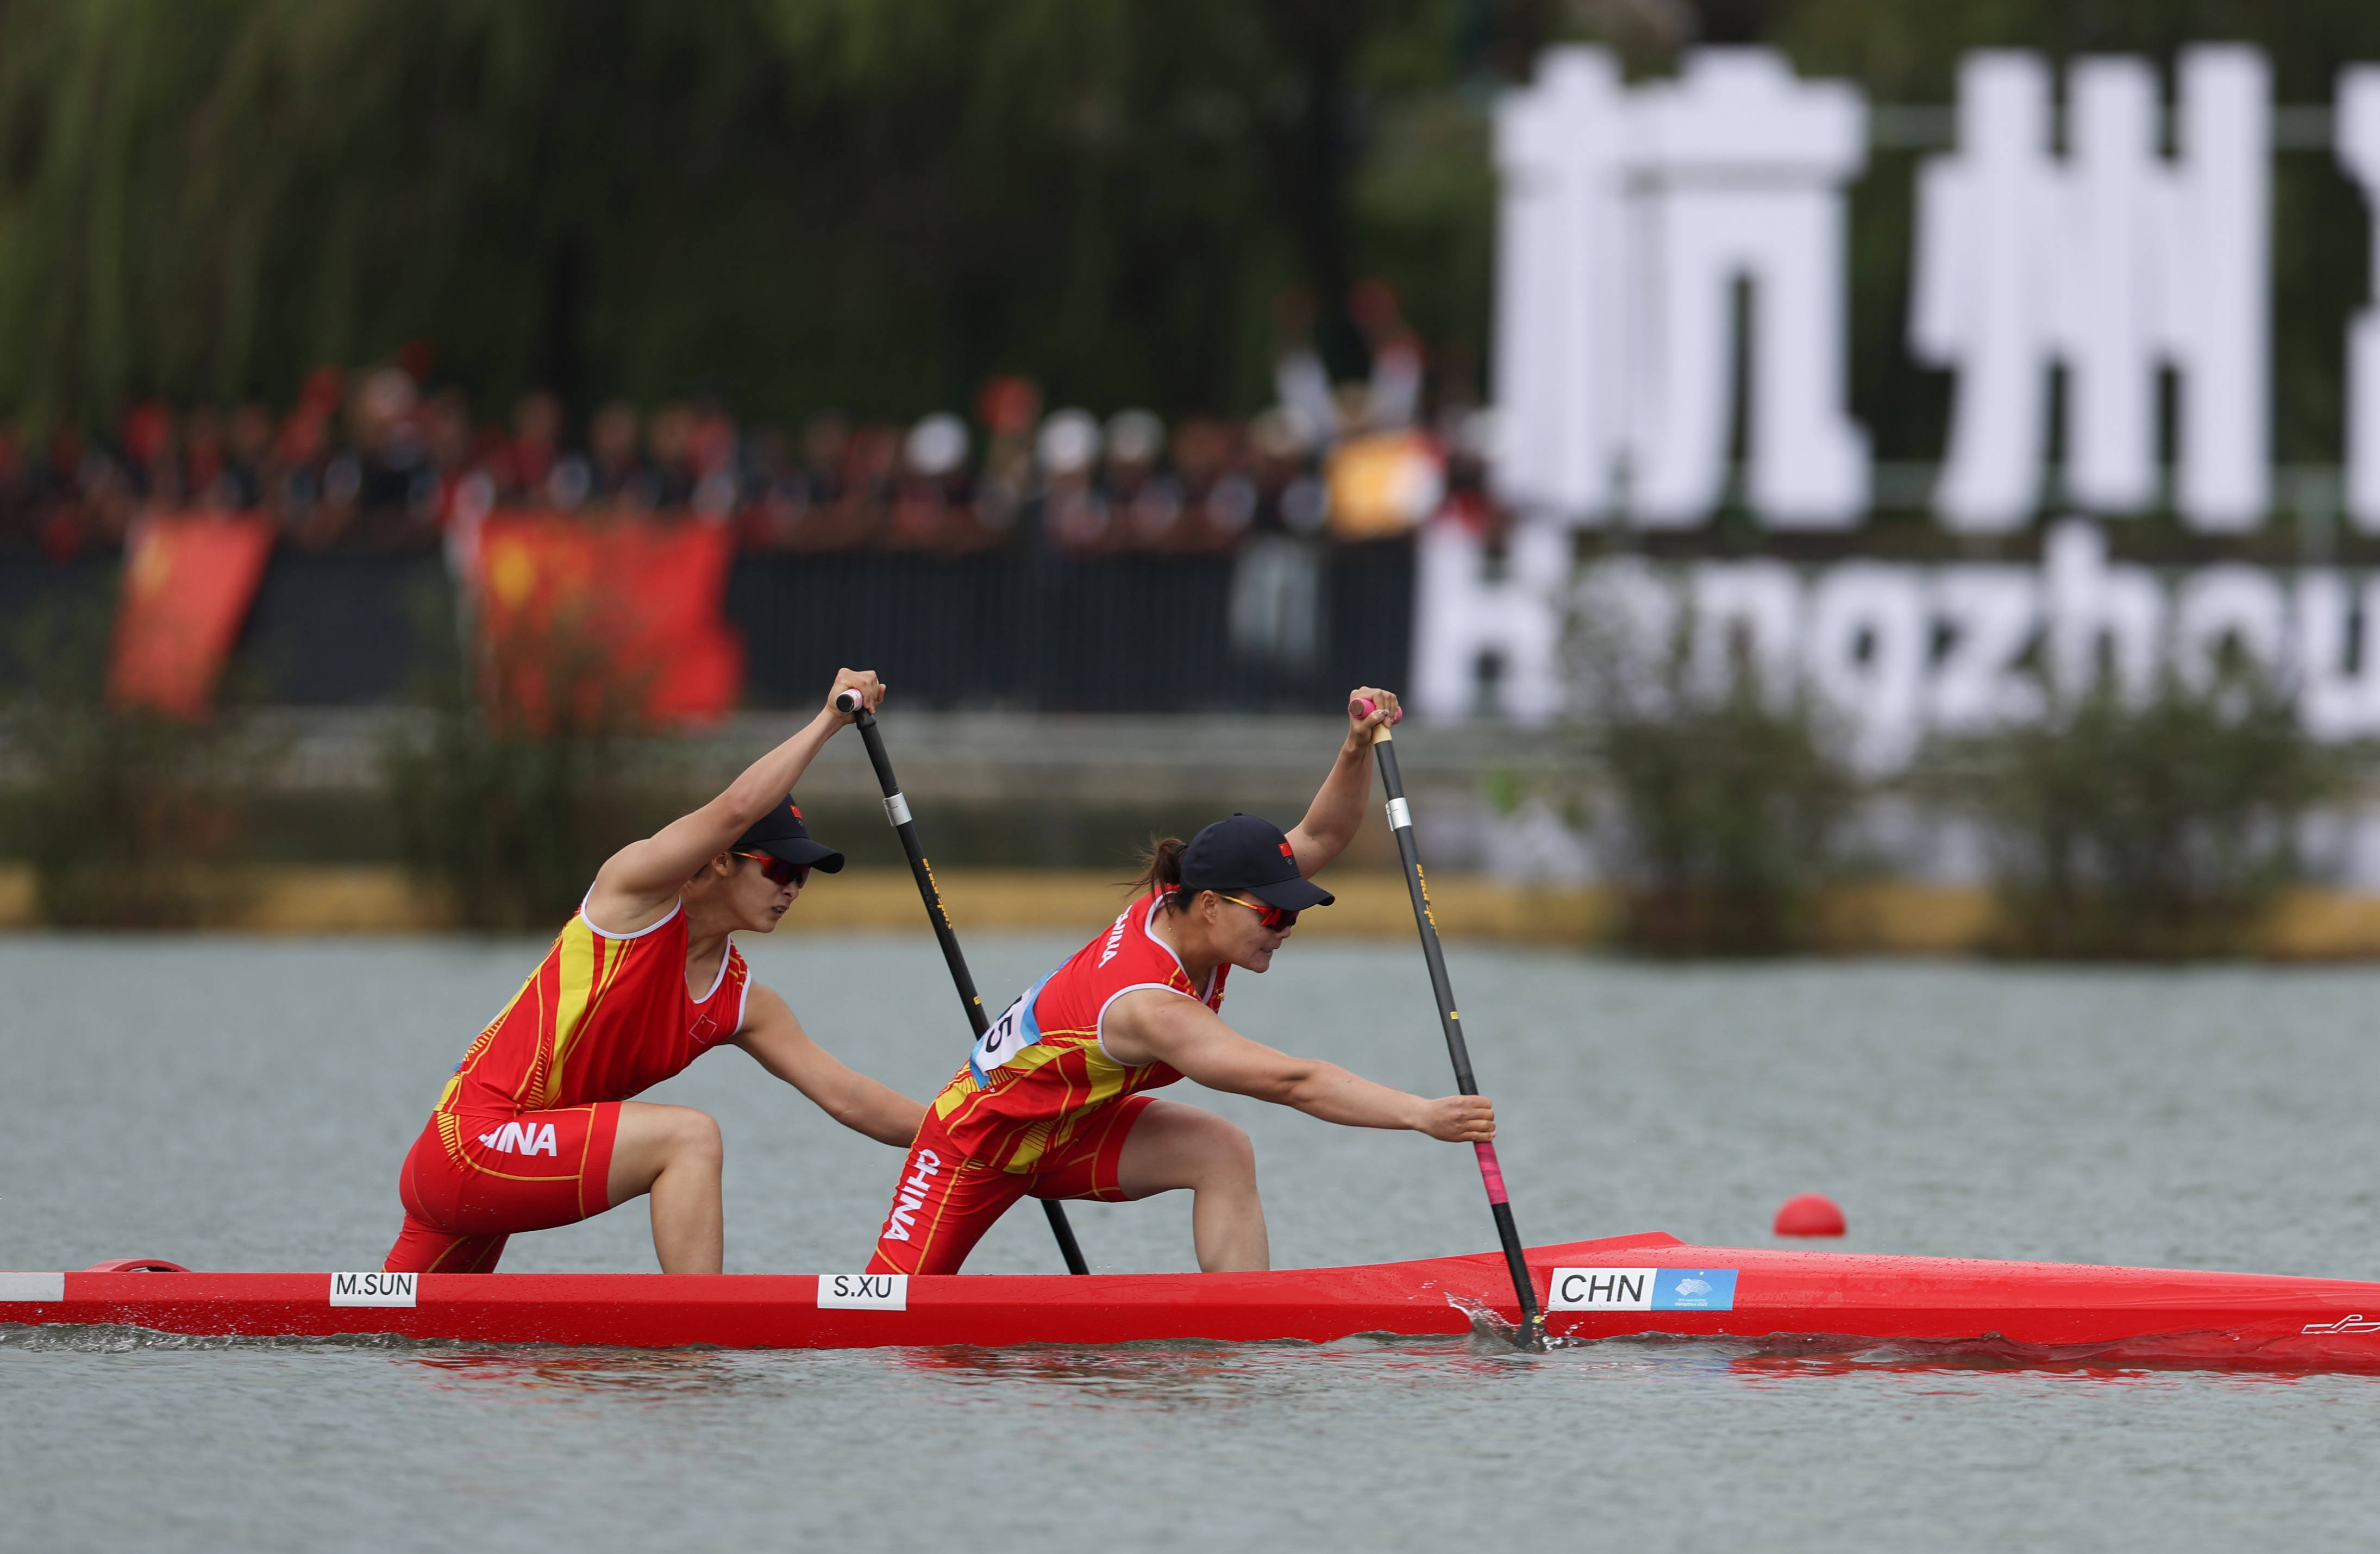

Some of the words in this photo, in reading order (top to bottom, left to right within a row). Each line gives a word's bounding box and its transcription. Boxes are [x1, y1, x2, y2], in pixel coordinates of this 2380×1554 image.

[882, 1149, 941, 1241] CHINA
[336, 1274, 412, 1295] M.SUN
[834, 1275, 892, 1298] S.XU
[1562, 1274, 1645, 1302] CHN
